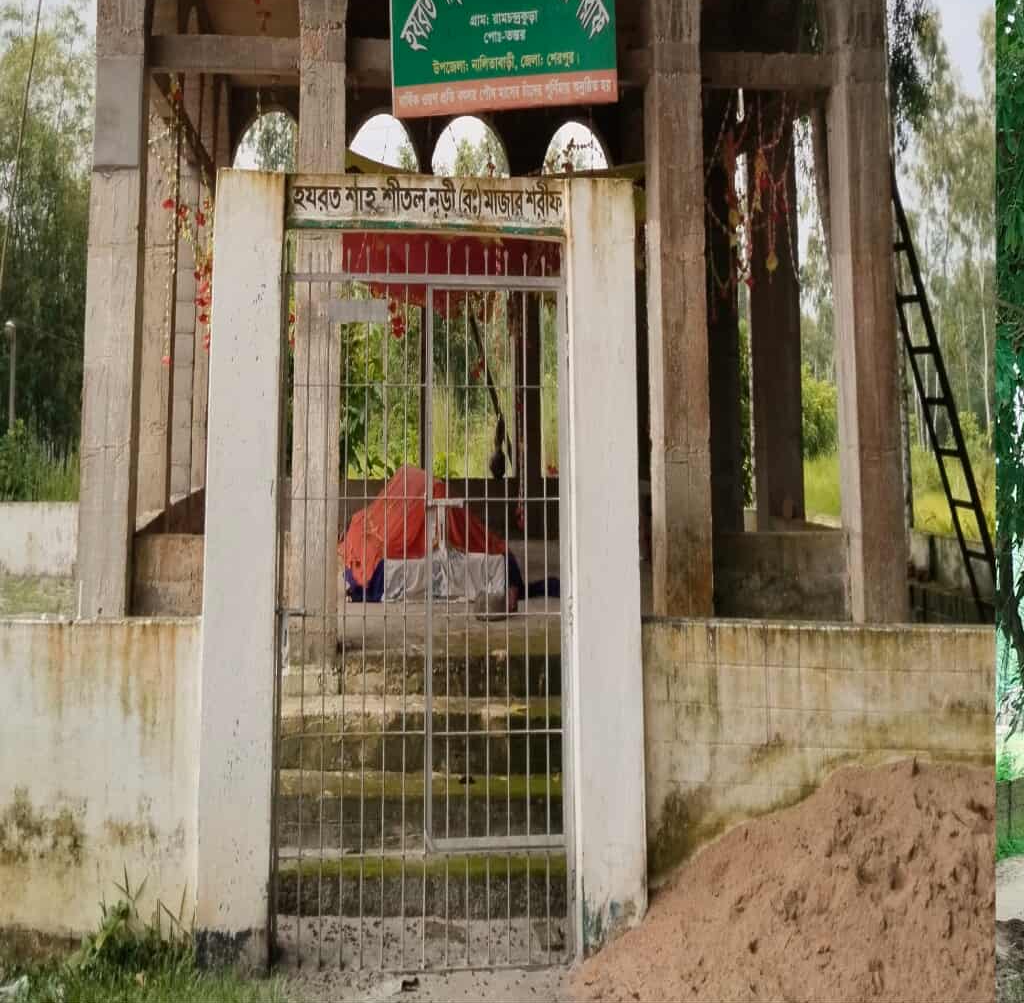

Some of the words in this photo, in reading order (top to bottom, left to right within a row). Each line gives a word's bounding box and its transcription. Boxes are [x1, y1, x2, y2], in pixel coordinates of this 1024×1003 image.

[293, 185, 342, 212] হযরত
[381, 176, 427, 214] শীতল
[482, 188, 524, 219] মাজার
[524, 180, 563, 219] শরীফ
